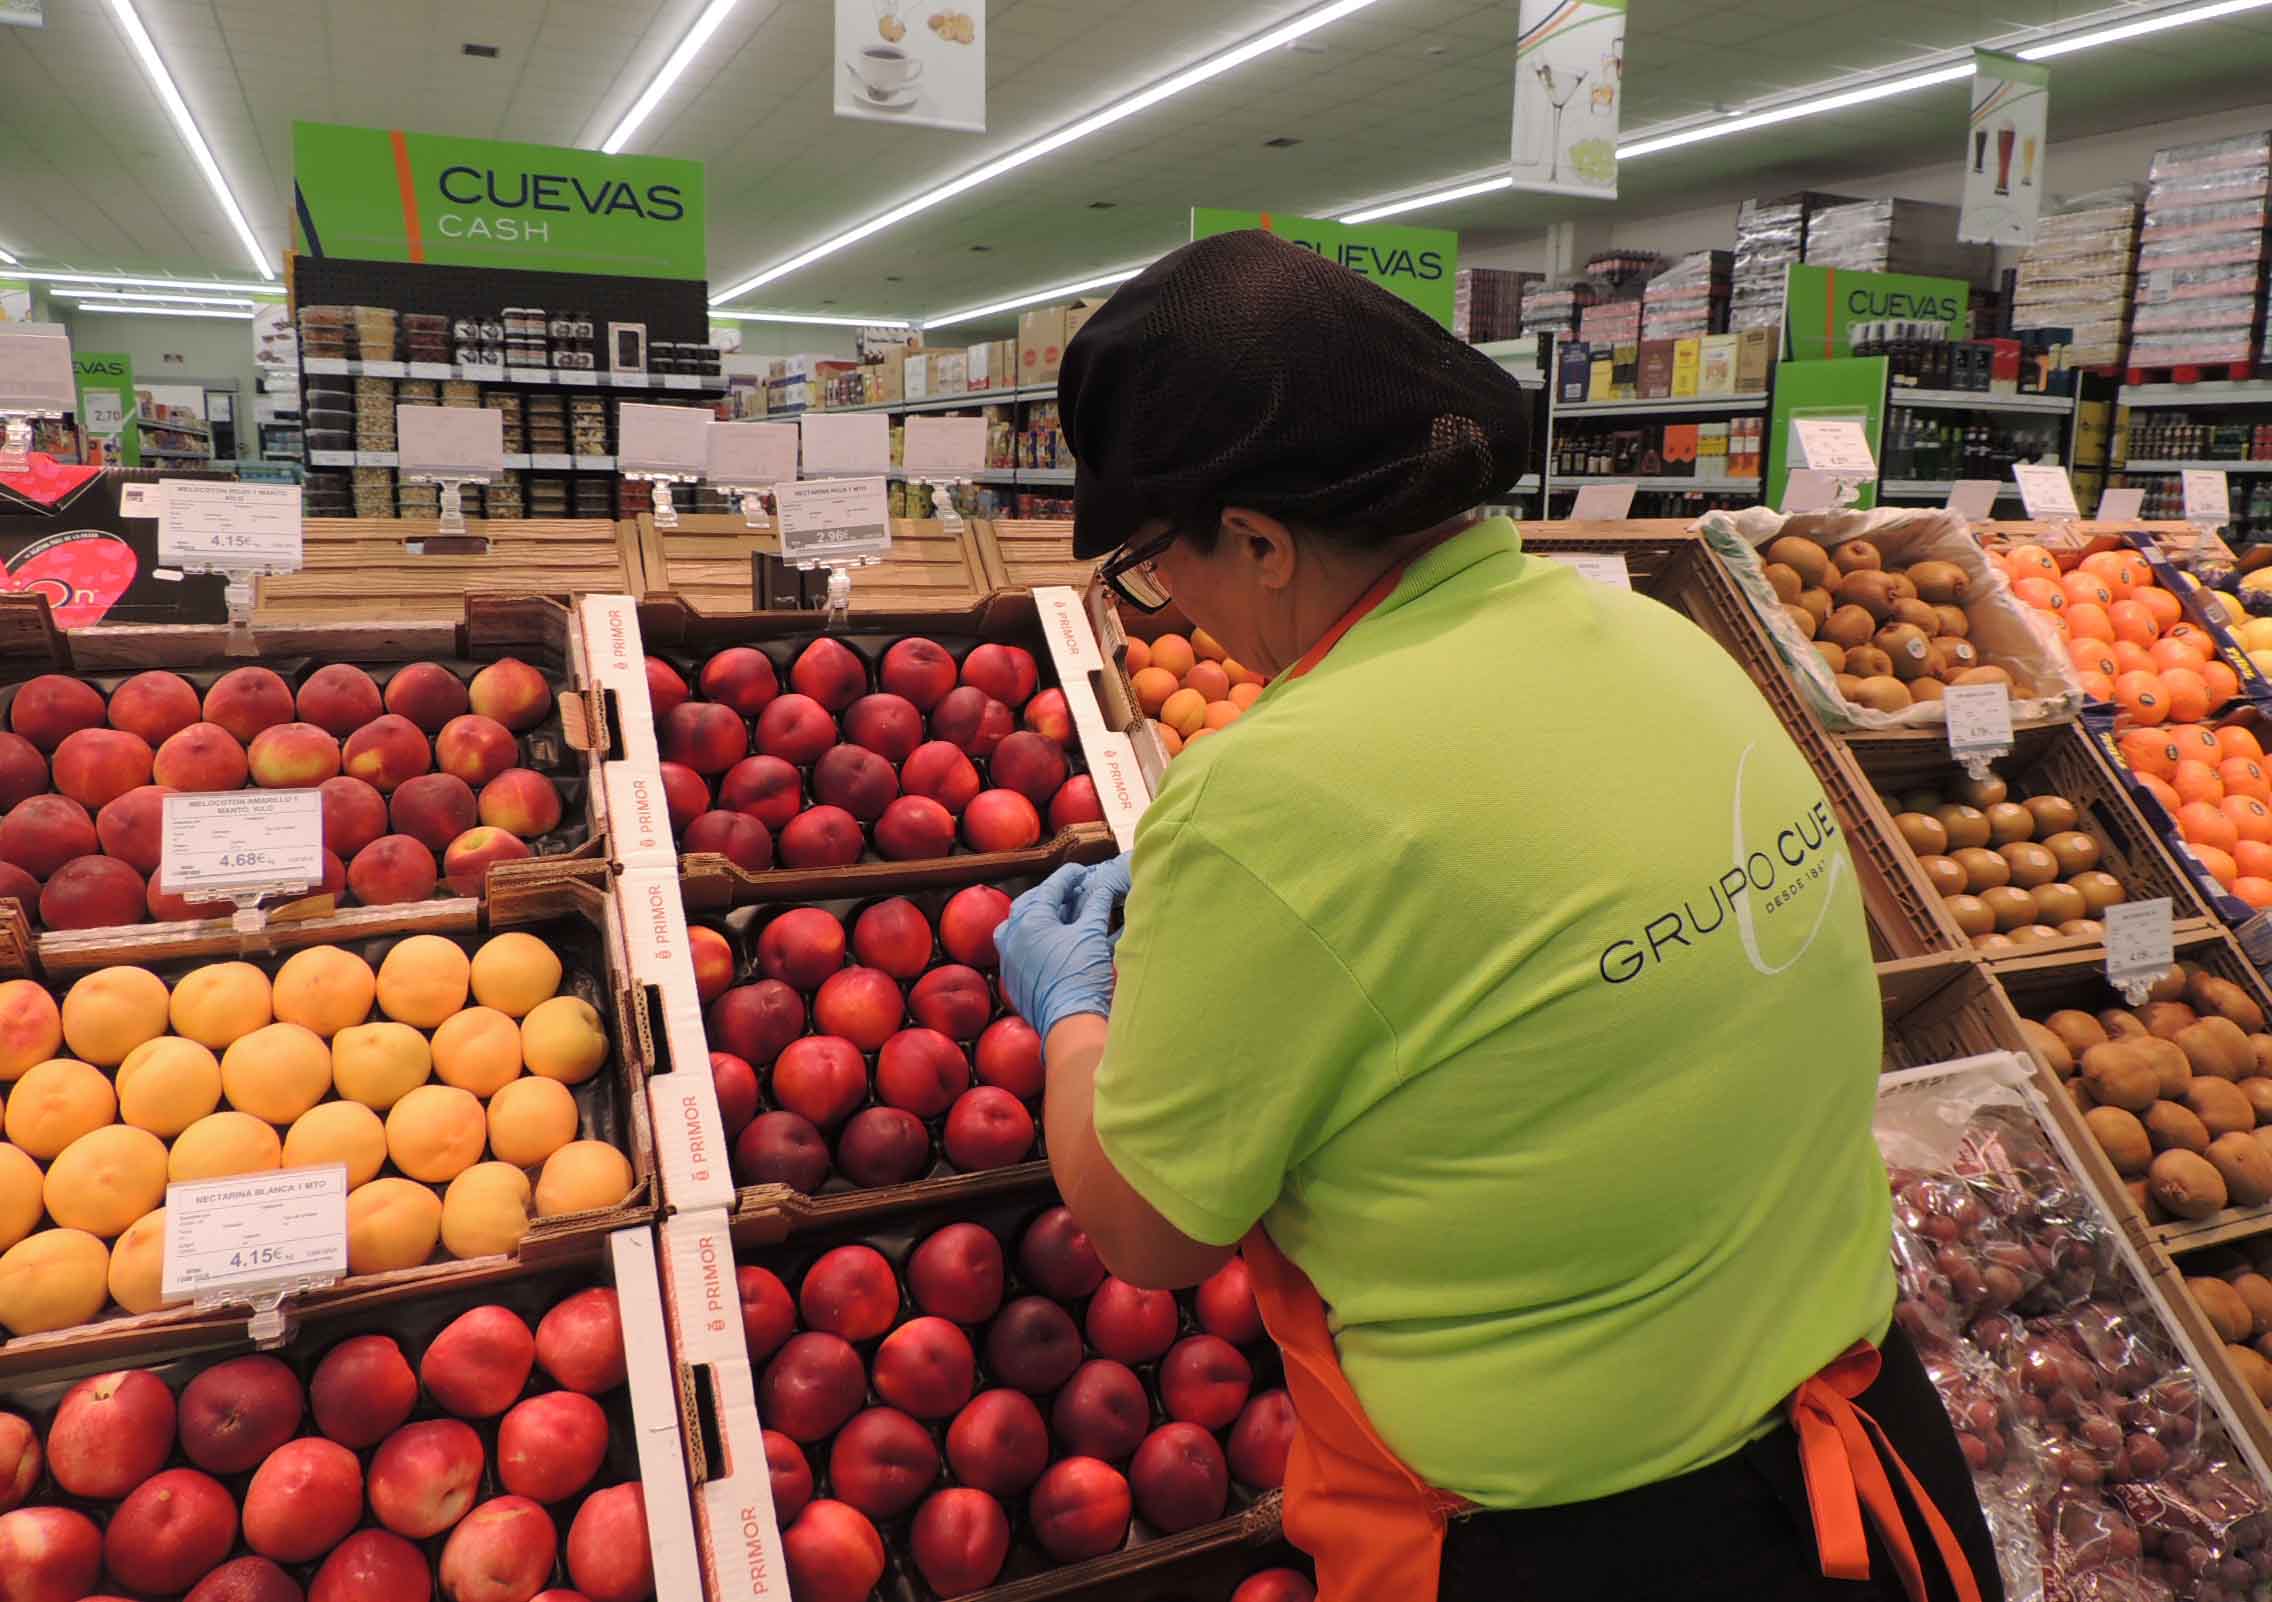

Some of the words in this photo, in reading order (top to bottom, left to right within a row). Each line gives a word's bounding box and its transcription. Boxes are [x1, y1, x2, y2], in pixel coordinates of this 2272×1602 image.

[438, 165, 685, 222] CUEVAS
[438, 214, 549, 243] CASH
[1293, 240, 1443, 281] EVAS
[1847, 289, 1958, 321] CUEVAS
[609, 609, 626, 658] PRIMOR
[1056, 611, 1080, 656] PRIMOR
[632, 778, 655, 839] PRIMOR
[1106, 760, 1133, 811] PRIMOR
[649, 882, 673, 945] PRIMOR
[1599, 852, 1776, 984] GRUPO
[1765, 877, 1805, 914] DESDE
[682, 1095, 706, 1164] PRIMOR
[195, 1190, 252, 1205] NECTARINA
[254, 1184, 296, 1197] BLANCA
[304, 1180, 328, 1190] MTO
[699, 1235, 723, 1313] PRIMOR
[740, 1506, 769, 1594] PRIMOR
